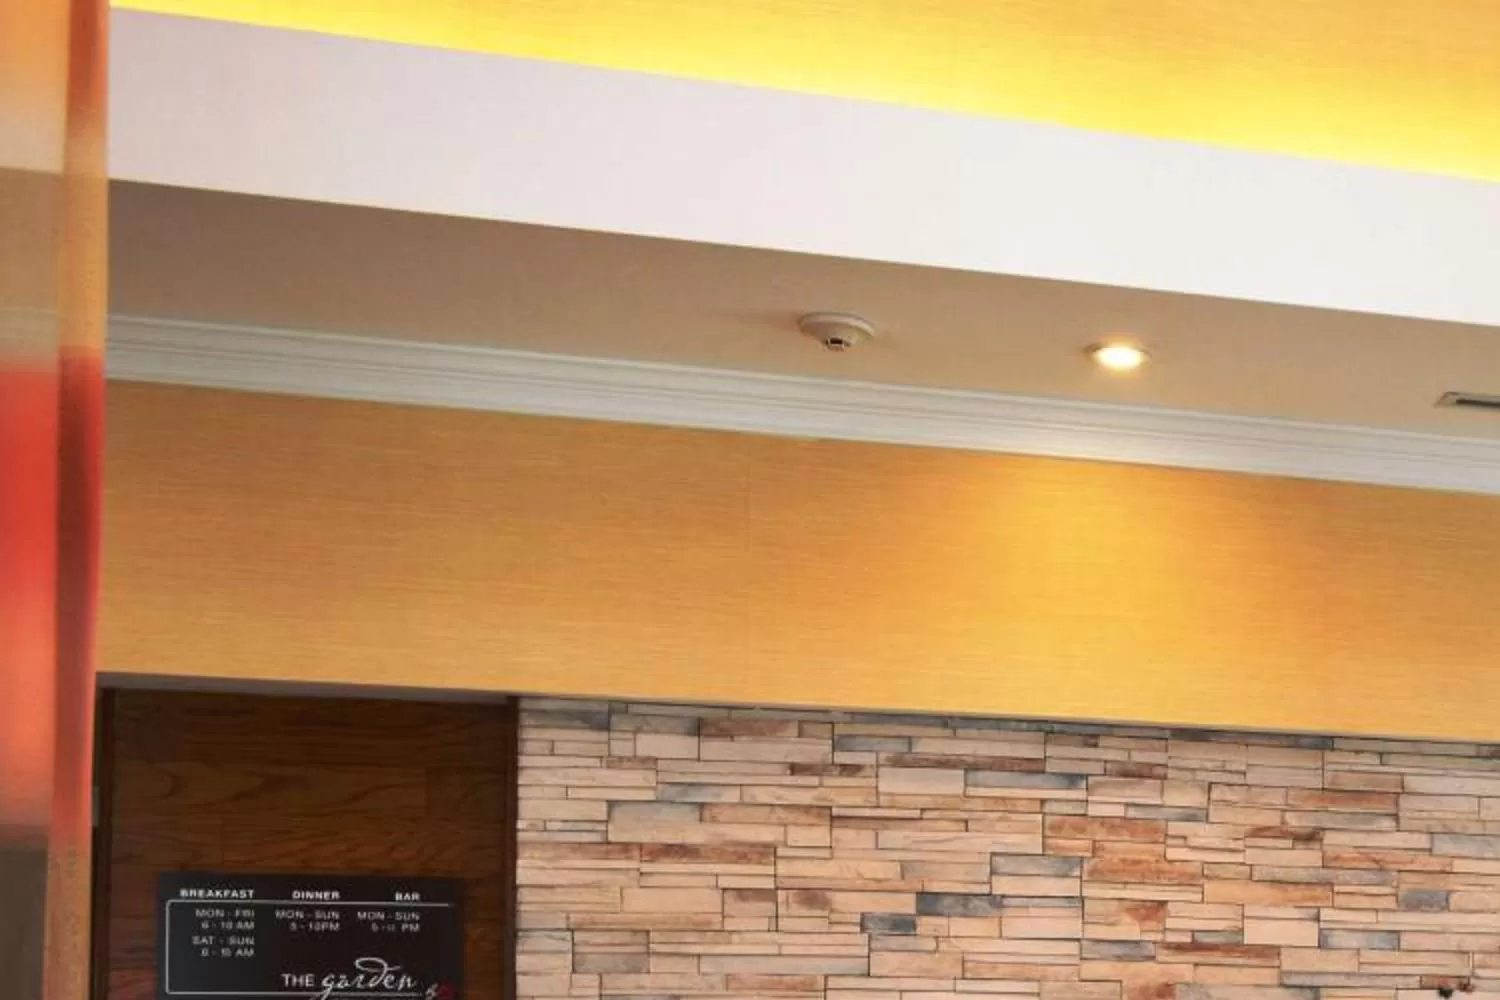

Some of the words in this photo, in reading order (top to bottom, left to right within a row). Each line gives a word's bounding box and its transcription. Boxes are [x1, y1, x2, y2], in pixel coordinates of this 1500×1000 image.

[179, 888, 255, 899] BREAKFAST
[292, 890, 340, 900] DINNER
[395, 891, 420, 901] BAR
[195, 908, 225, 917] MON
[235, 908, 255, 918] FRI
[275, 909, 304, 919] MON
[315, 910, 340, 920] SUN
[357, 911, 385, 920] MON
[395, 911, 420, 921] SUN
[236, 921, 255, 930] AM
[401, 923, 420, 932] PM
[192, 936, 214, 945] SAT
[229, 936, 255, 945] SUN
[236, 948, 255, 957] AM
[281, 973, 315, 987] THE
